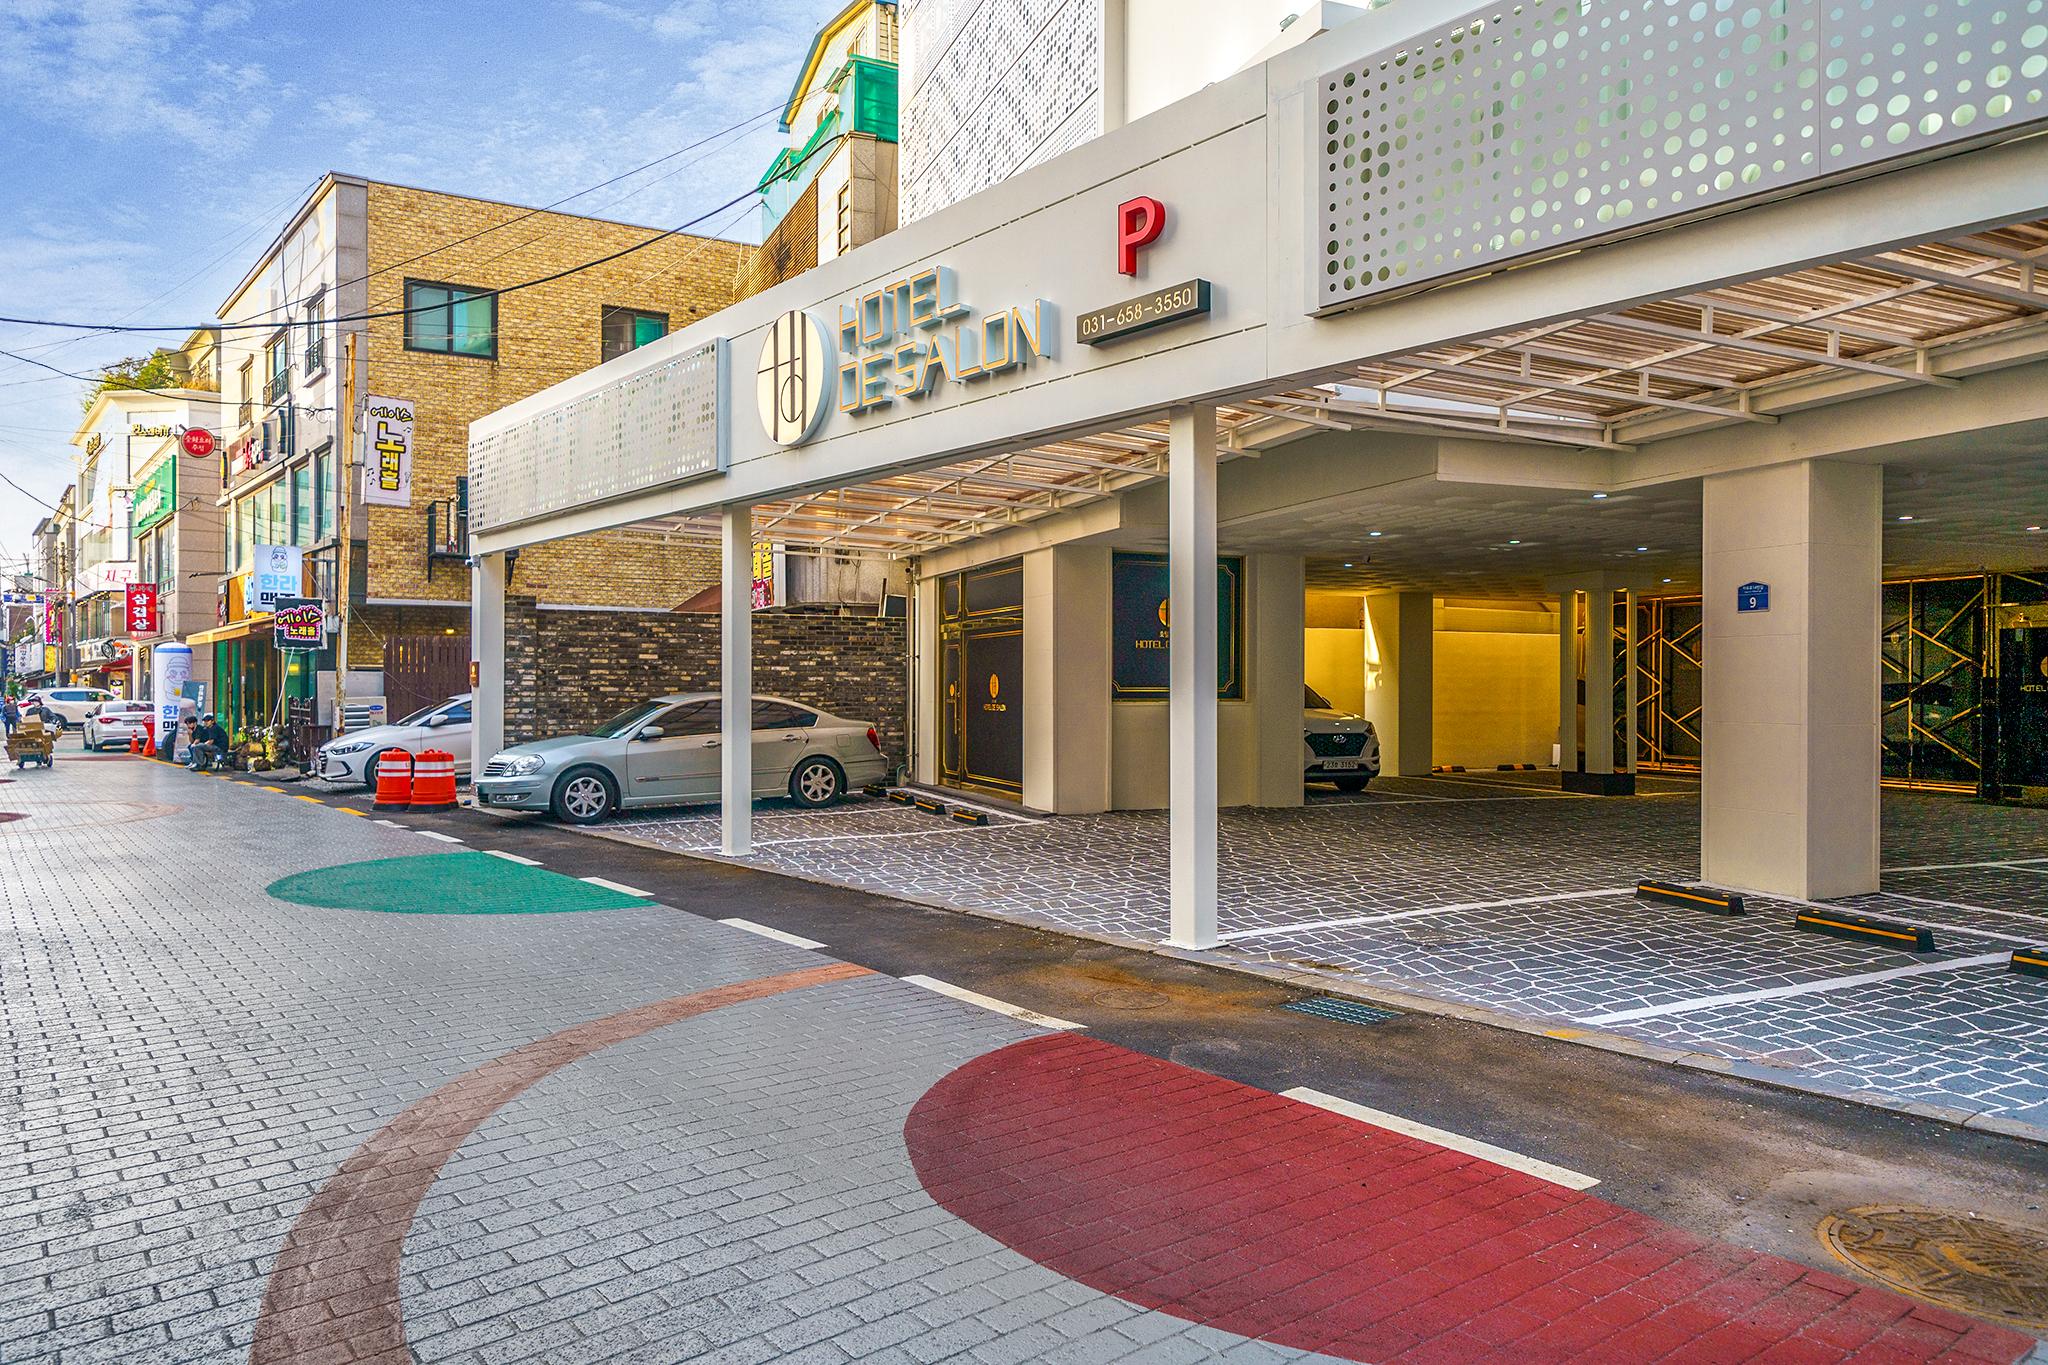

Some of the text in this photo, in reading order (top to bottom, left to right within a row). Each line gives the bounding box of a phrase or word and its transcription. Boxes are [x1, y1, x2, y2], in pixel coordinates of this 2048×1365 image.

[1118, 196, 1166, 277] P
[839, 265, 970, 354] HOTEL
[1082, 287, 1192, 336] 031-658-3550
[370, 406, 413, 422] 에이스
[375, 420, 406, 491] 노래홀
[260, 573, 297, 591] 한라
[260, 592, 296, 605] 맥
[1749, 596, 1757, 608] 9
[132, 593, 150, 630] 삼겹살
[277, 609, 321, 624] 에이스
[289, 626, 316, 637] 노래홀
